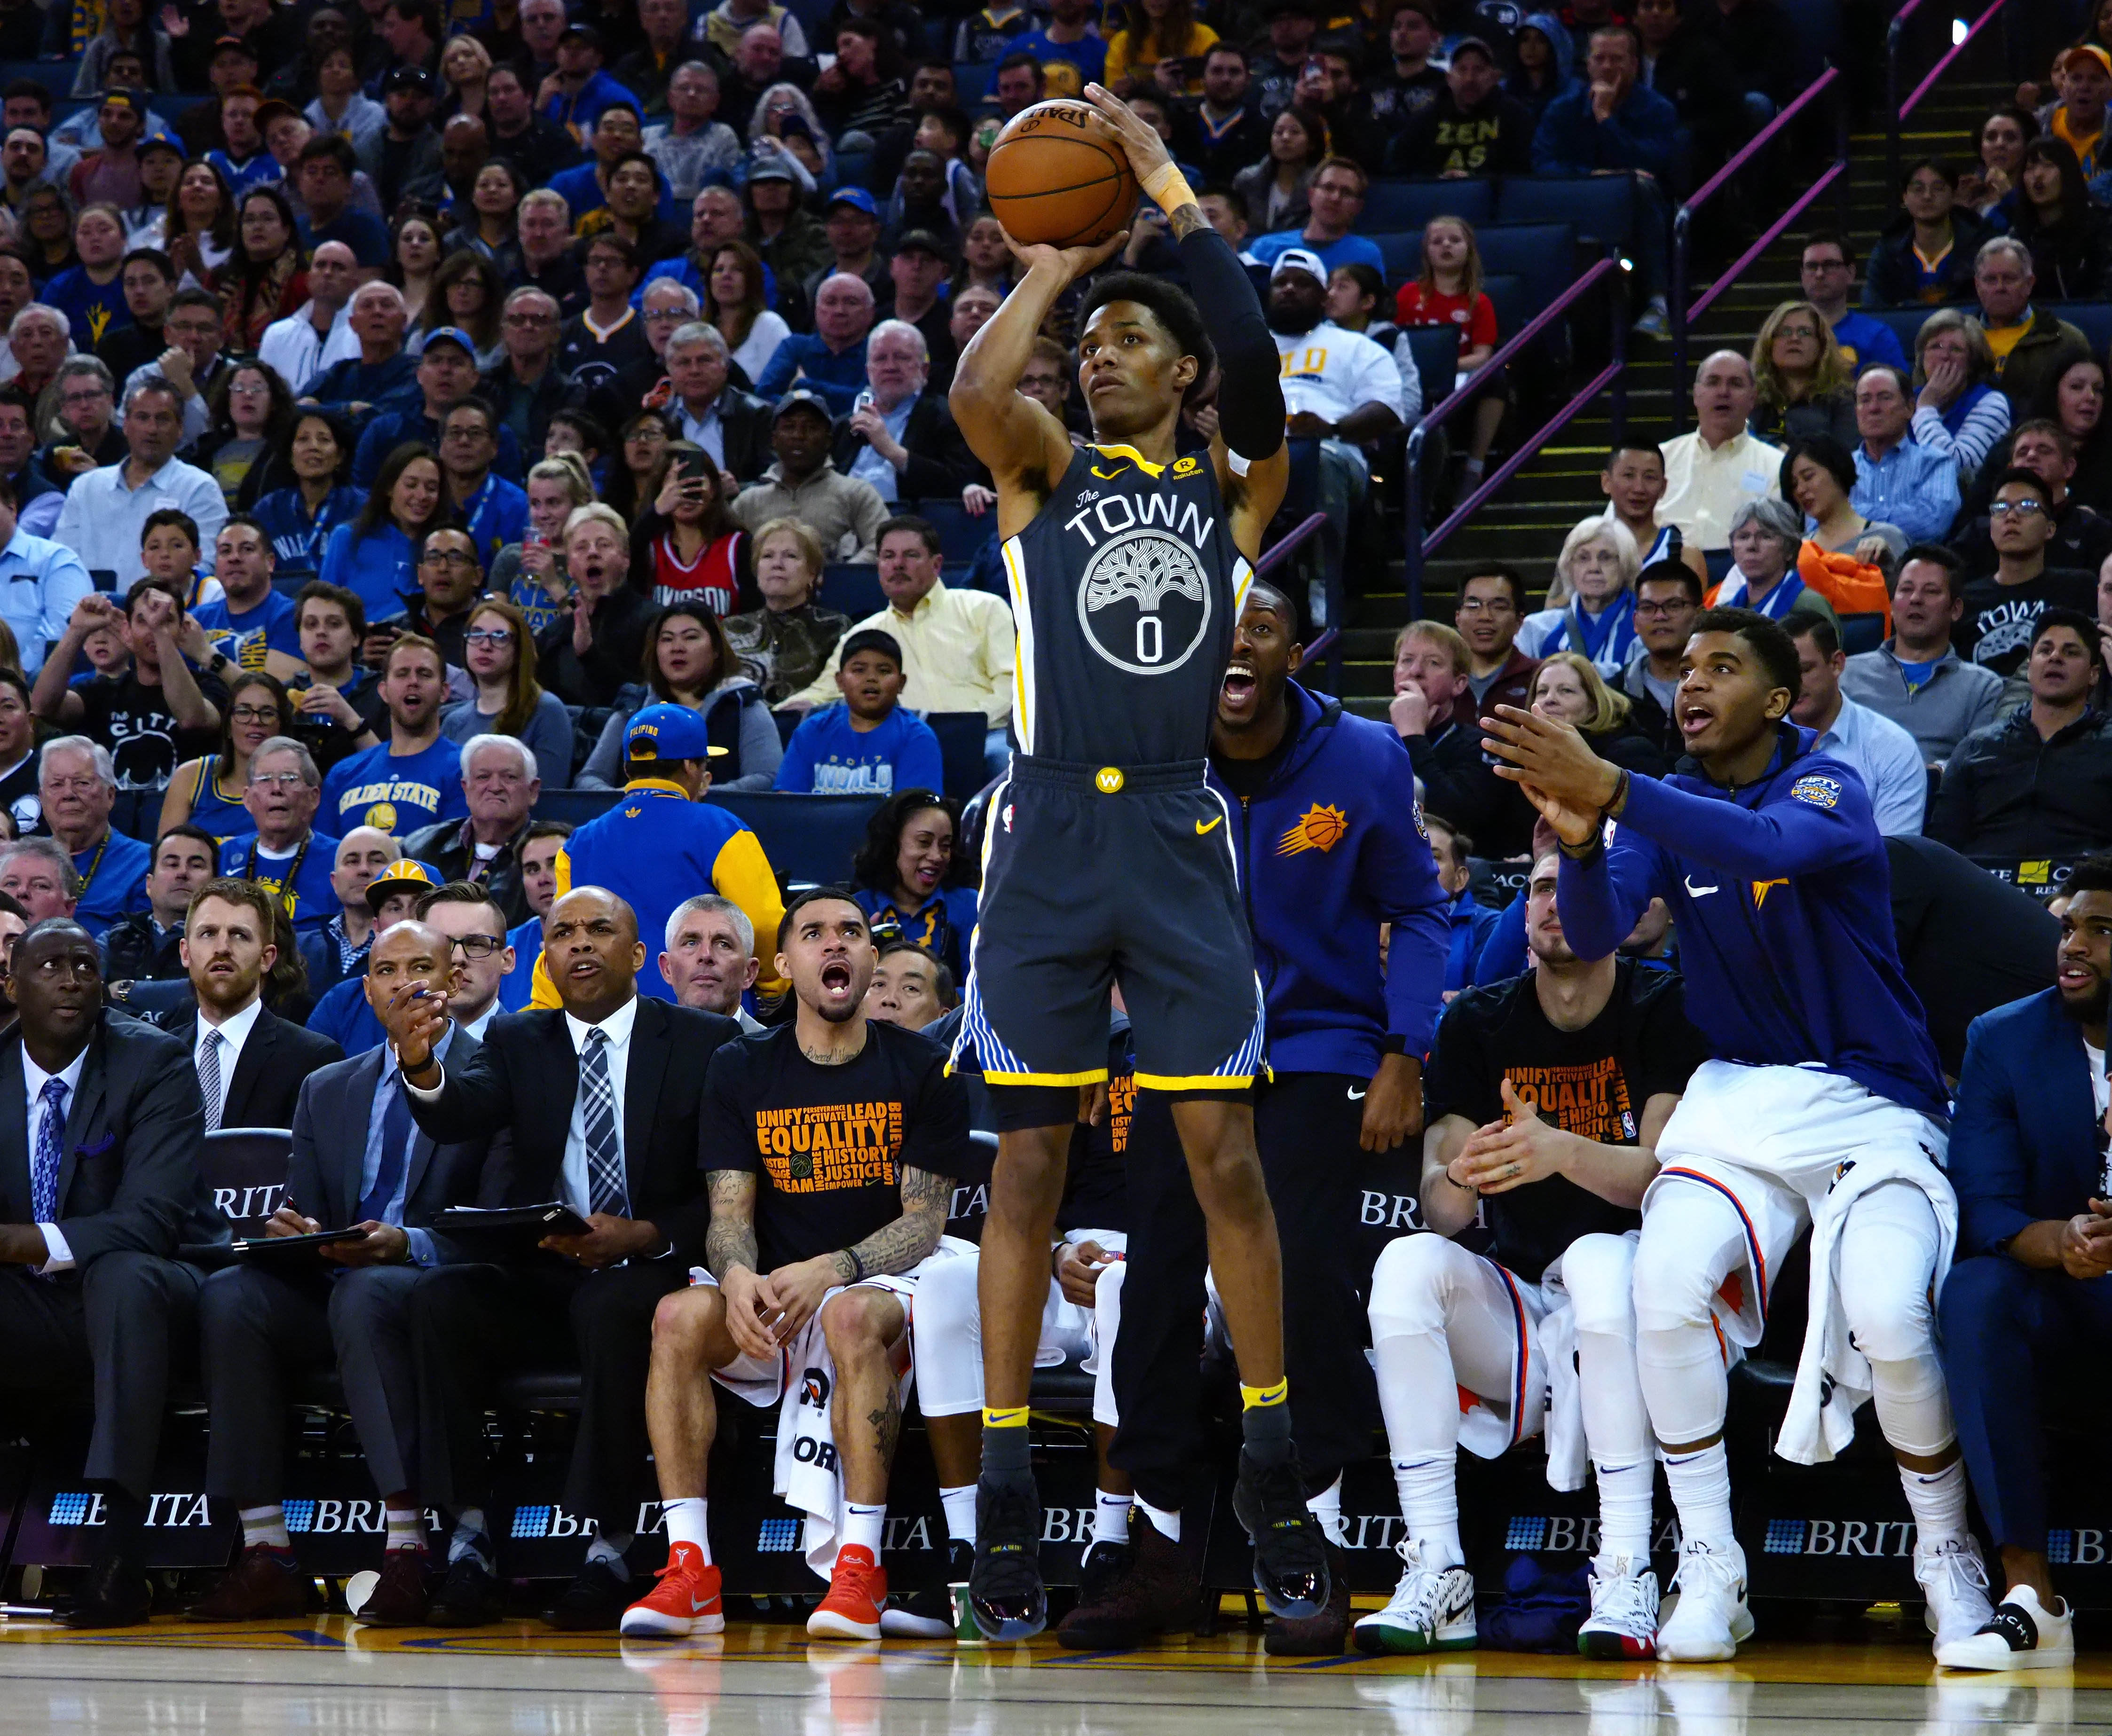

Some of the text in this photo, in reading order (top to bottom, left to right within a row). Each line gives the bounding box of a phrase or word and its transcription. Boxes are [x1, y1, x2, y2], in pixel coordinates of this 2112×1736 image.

[1173, 468, 1204, 480] Rakuten
[1180, 461, 1190, 470] R
[1076, 489, 1100, 508] The
[1064, 493, 1214, 550] TOWN
[1136, 616, 1163, 662] 0
[110, 712, 177, 737] CITY
[814, 763, 893, 789] WORLD
[1099, 774, 1120, 788] W
[1798, 777, 1840, 790] FIFTY
[339, 781, 441, 816] GOLDEN STATE
[1504, 1067, 1551, 1085] UNIFY
[1593, 1056, 1616, 1078] LEA
[756, 1108, 802, 1128] UNIFY
[803, 1105, 846, 1114] PERSEVERANCE
[804, 1111, 846, 1123] ACTIVATE
[847, 1102, 887, 1121] LEAD
[1569, 1100, 1613, 1124] HISTO
[757, 1119, 887, 1156] EQUALITY
[1611, 1115, 1624, 1141] LOVE
[823, 1146, 888, 1165] HISTORY
[812, 1150, 825, 1192] INSPIRE
[825, 1162, 882, 1182] JUSTICE
[883, 1161, 894, 1186] LOVE
[825, 1178, 863, 1191] EMPOWER
[214, 1184, 284, 1218] RIT
[1361, 1190, 1489, 1230] BRA
[312, 1500, 443, 1533] BRIA
[1338, 1515, 1410, 1549] RIT
[1804, 1520, 1916, 1557] BRIT
[1991, 1614, 2029, 1644] NCHY
